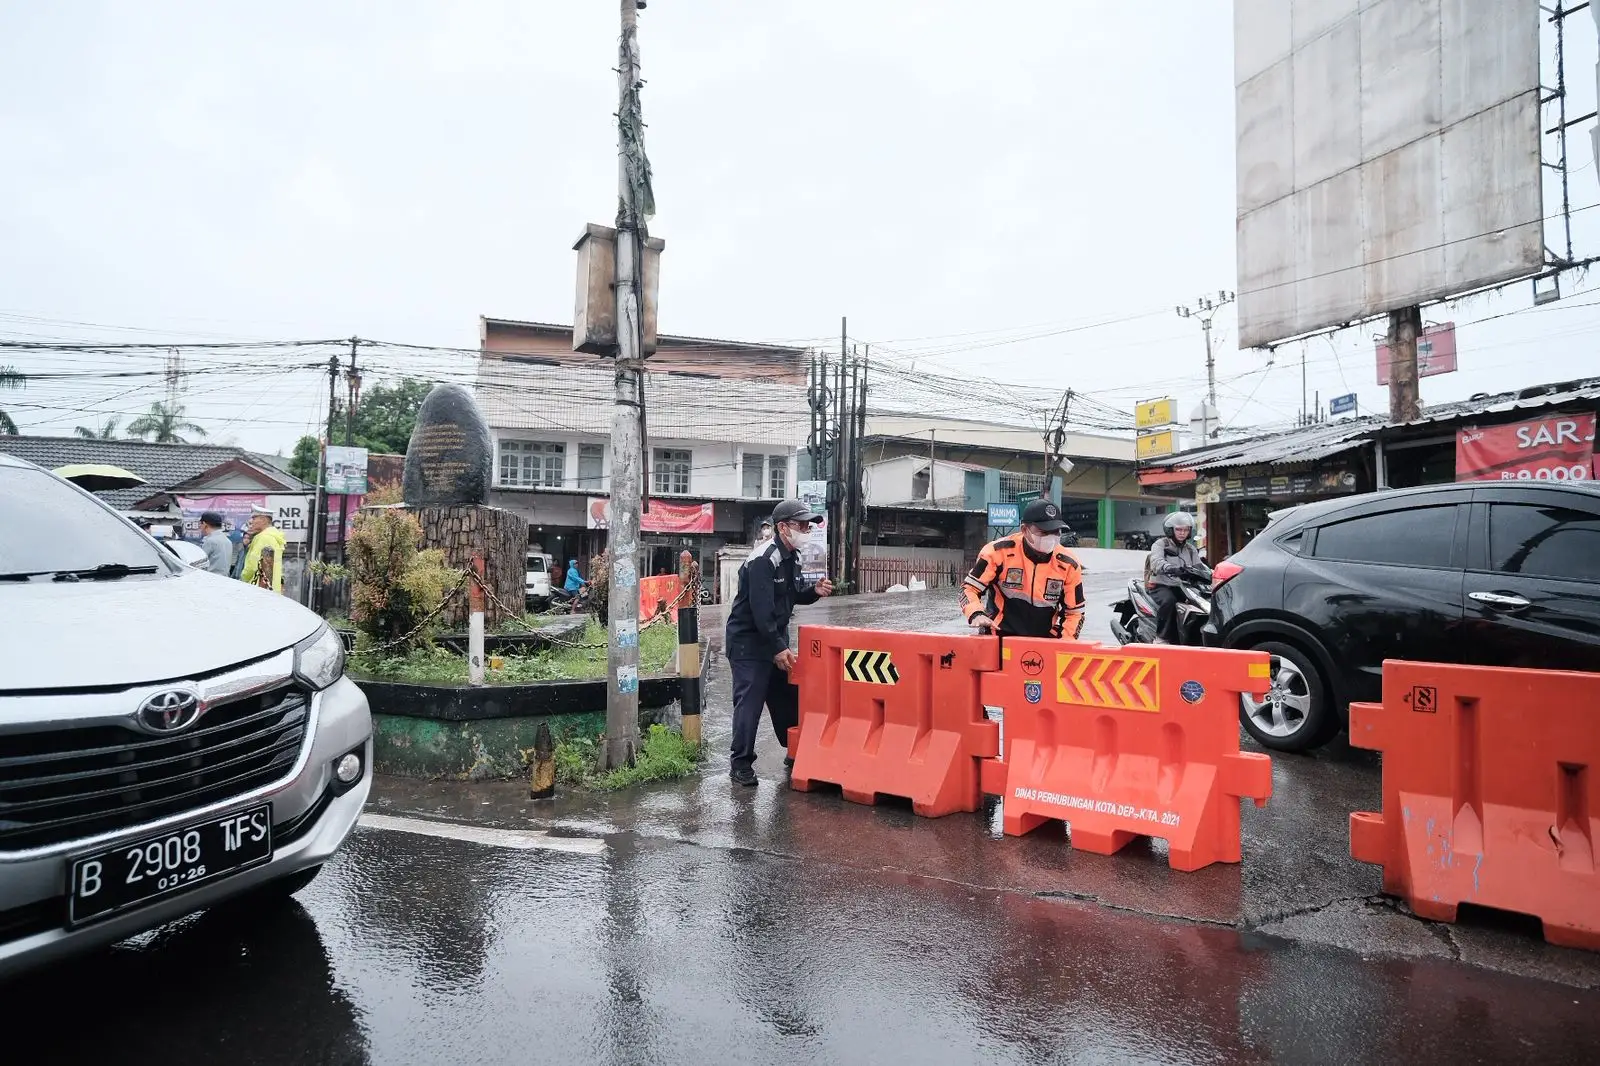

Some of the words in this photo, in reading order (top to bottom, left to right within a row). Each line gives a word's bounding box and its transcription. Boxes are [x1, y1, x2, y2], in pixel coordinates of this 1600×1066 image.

[271, 519, 308, 530] CELL
[279, 507, 301, 518] NR
[1015, 787, 1037, 801] DINAS
[1037, 792, 1094, 811] PERHUBUNGAN
[1095, 801, 1117, 815] KOTA
[1161, 811, 1181, 827] 2021
[80, 861, 102, 897] B
[126, 831, 201, 884] 2908
[220, 812, 266, 851] TFS
